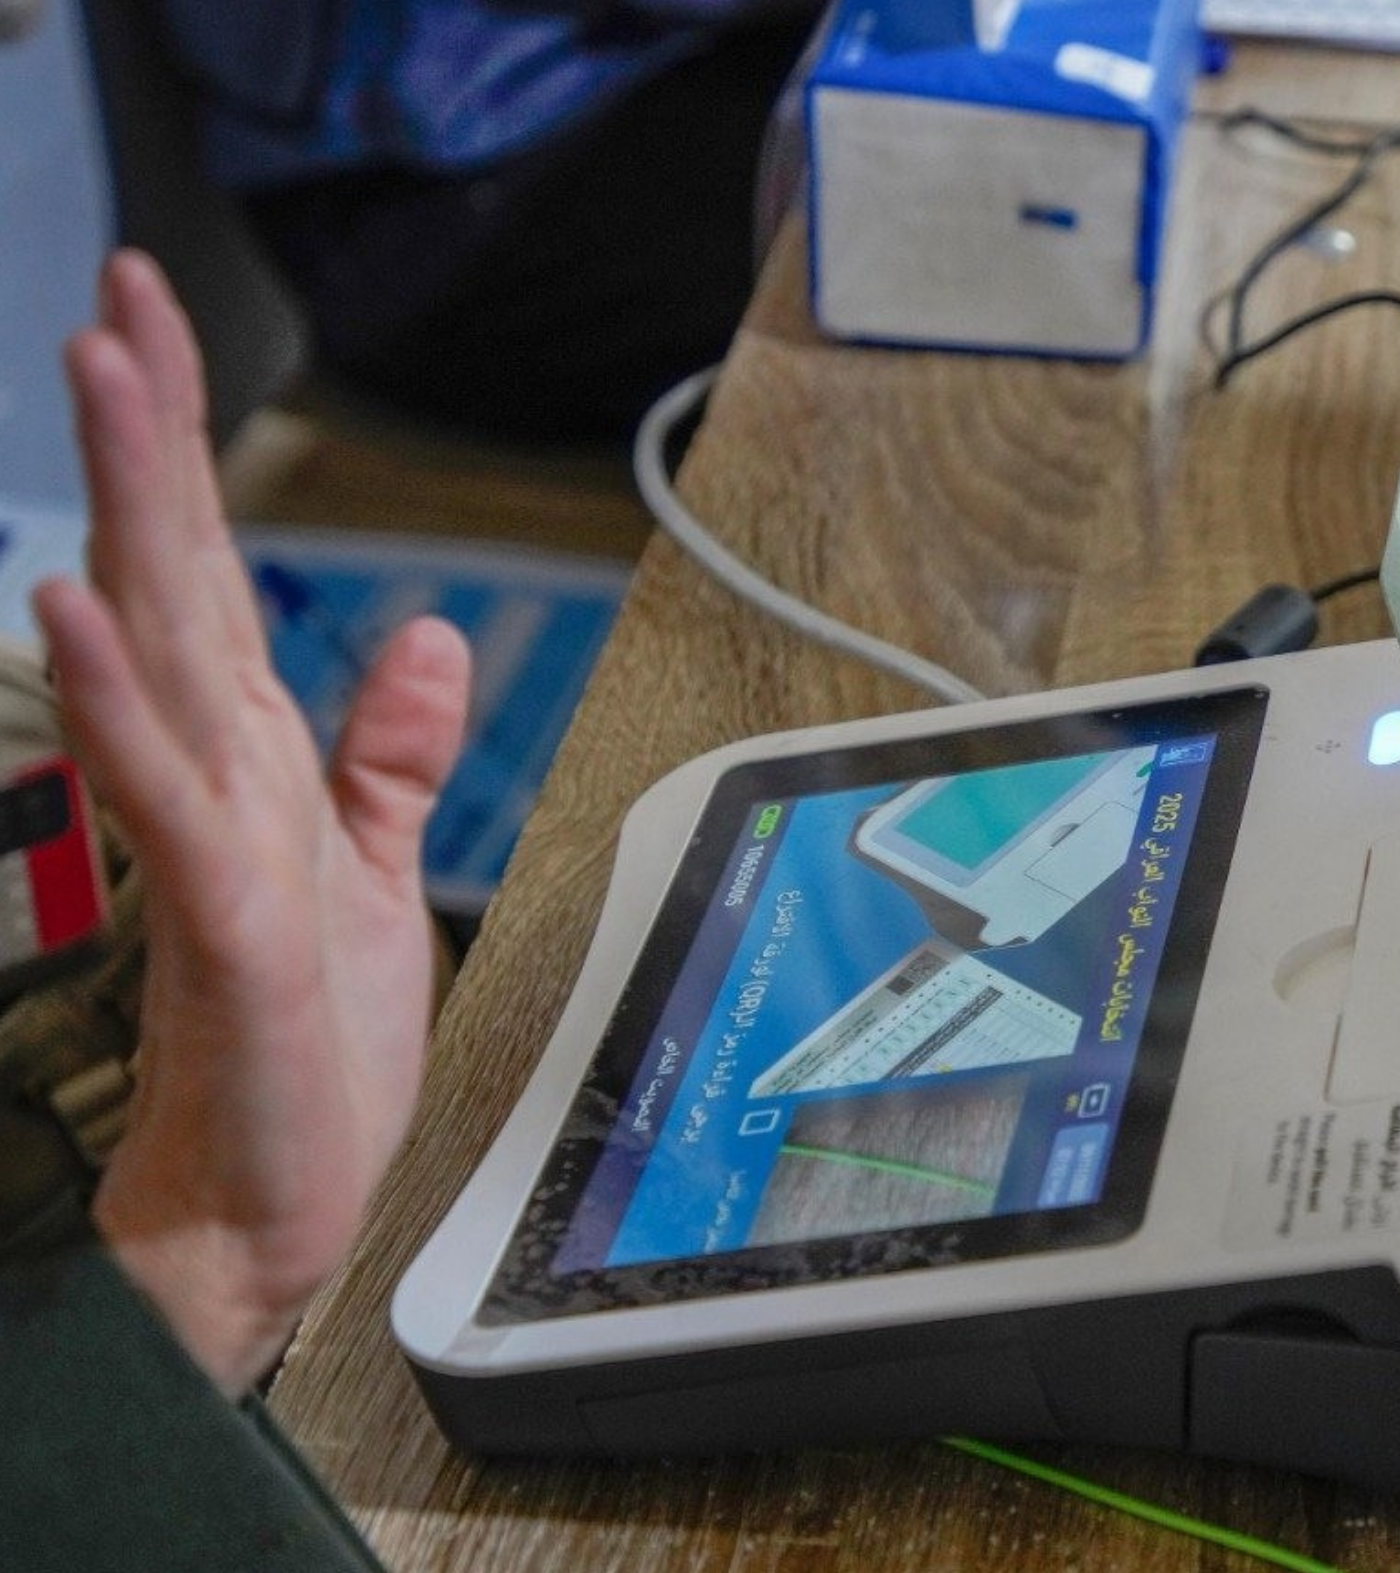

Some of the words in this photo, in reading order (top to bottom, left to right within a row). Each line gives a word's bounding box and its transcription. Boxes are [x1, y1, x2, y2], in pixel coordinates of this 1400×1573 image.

[1152, 793, 1183, 832] 2025
[1128, 886, 1158, 928] النواب
[1113, 933, 1145, 977] مجلس
[1100, 981, 1133, 1041] انتخابات
[630, 1079, 664, 1132] التصويت
[656, 1037, 680, 1075] الخاص
